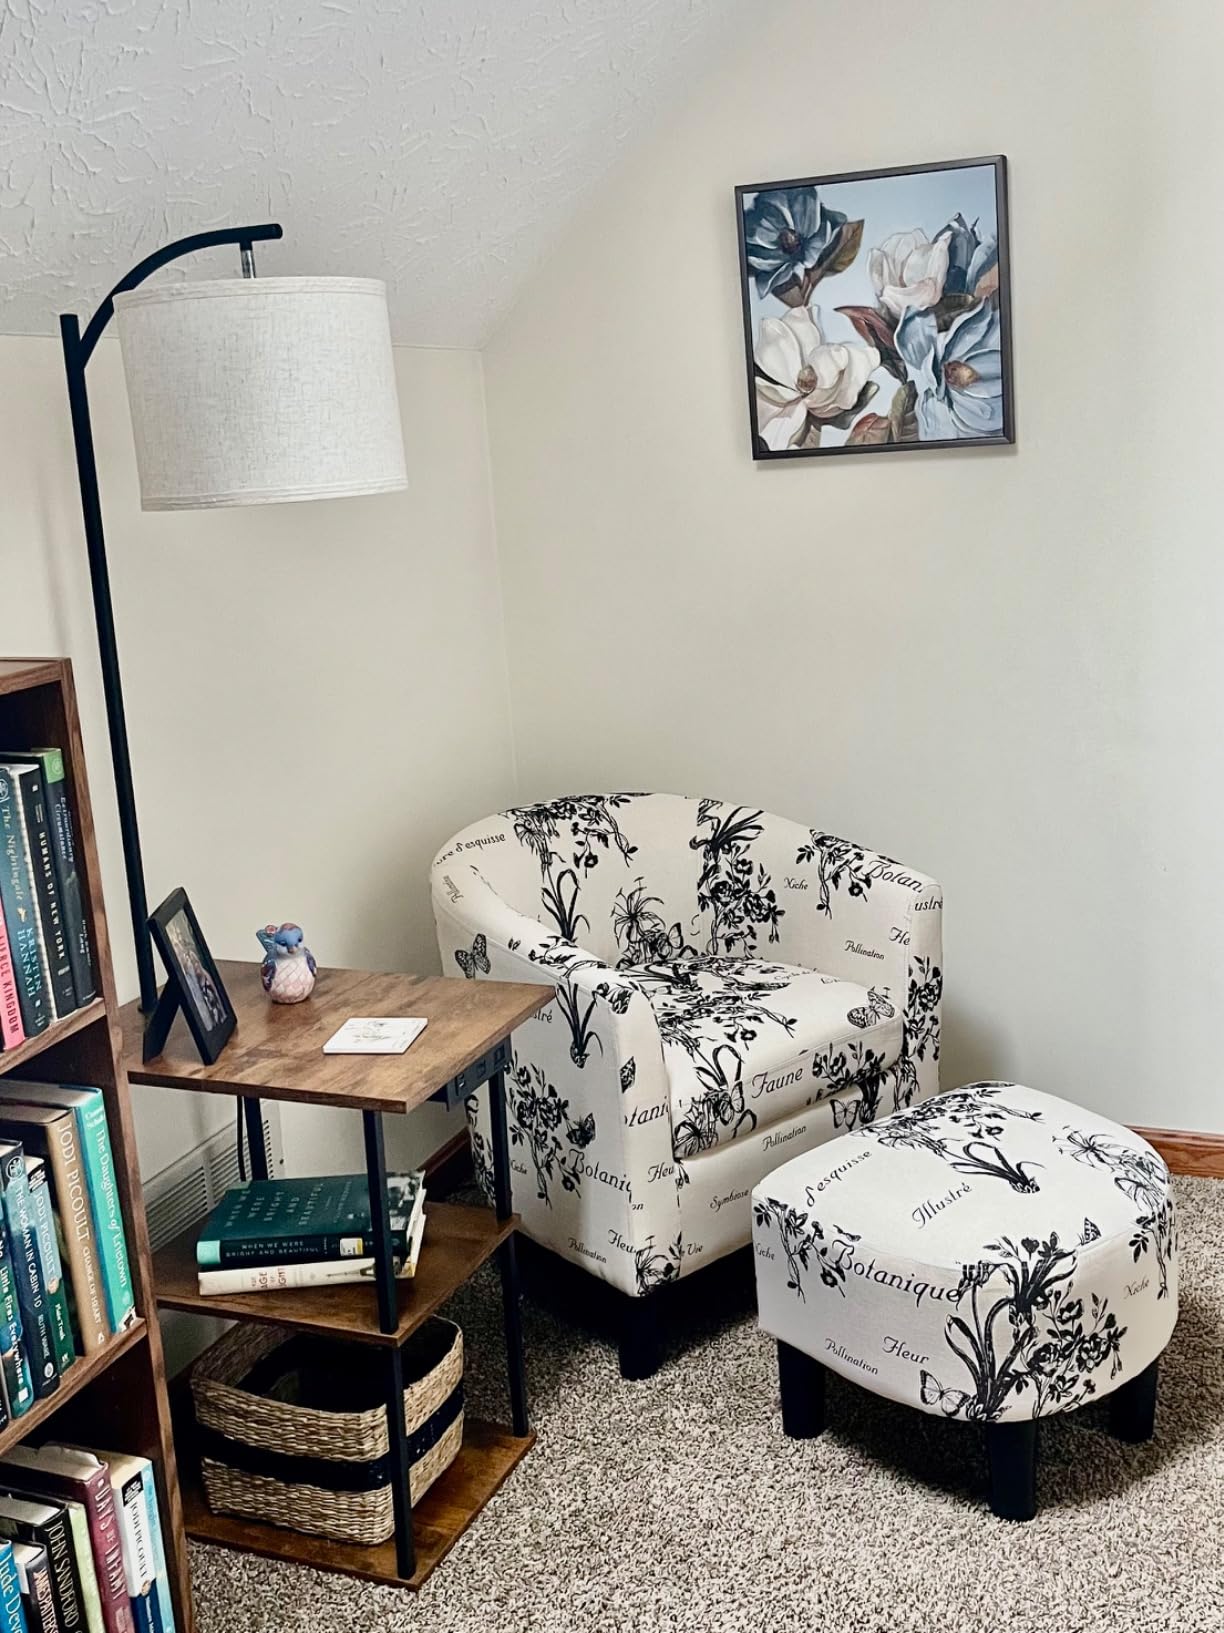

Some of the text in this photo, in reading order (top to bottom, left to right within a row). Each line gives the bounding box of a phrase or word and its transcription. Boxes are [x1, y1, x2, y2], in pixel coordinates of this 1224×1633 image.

[2, 805, 25, 900] The Nightingale
[39, 831, 65, 959] HUMANS OF NEW YORK
[17, 929, 36, 998] HANNAH
[26, 927, 42, 992] KRISTIN
[3, 980, 20, 1034] KINGDOM
[752, 1067, 804, 1099] Faune
[96, 1127, 107, 1154] The
[33, 1190, 48, 1222] JODI
[58, 1121, 91, 1242] JODI PICOULT
[100, 1153, 116, 1218] Daughters
[911, 1182, 973, 1229] Illustré
[16, 1186, 43, 1309] THE WOMAN IN CABIN 10
[40, 1222, 56, 1275] PICOULT
[108, 1219, 121, 1231] of
[82, 1246, 96, 1282] CHANGE
[829, 1239, 962, 1309] Botanique
[5, 1294, 14, 1323] Fires
[8, 1321, 25, 1386] Everywhere
[824, 1337, 879, 1375] Pollination
[882, 1335, 930, 1365] Fleur
[95, 1486, 115, 1532] DAYS
[105, 1541, 128, 1601] INFAMY
[45, 1519, 80, 1628] JOHN SANDFORD
